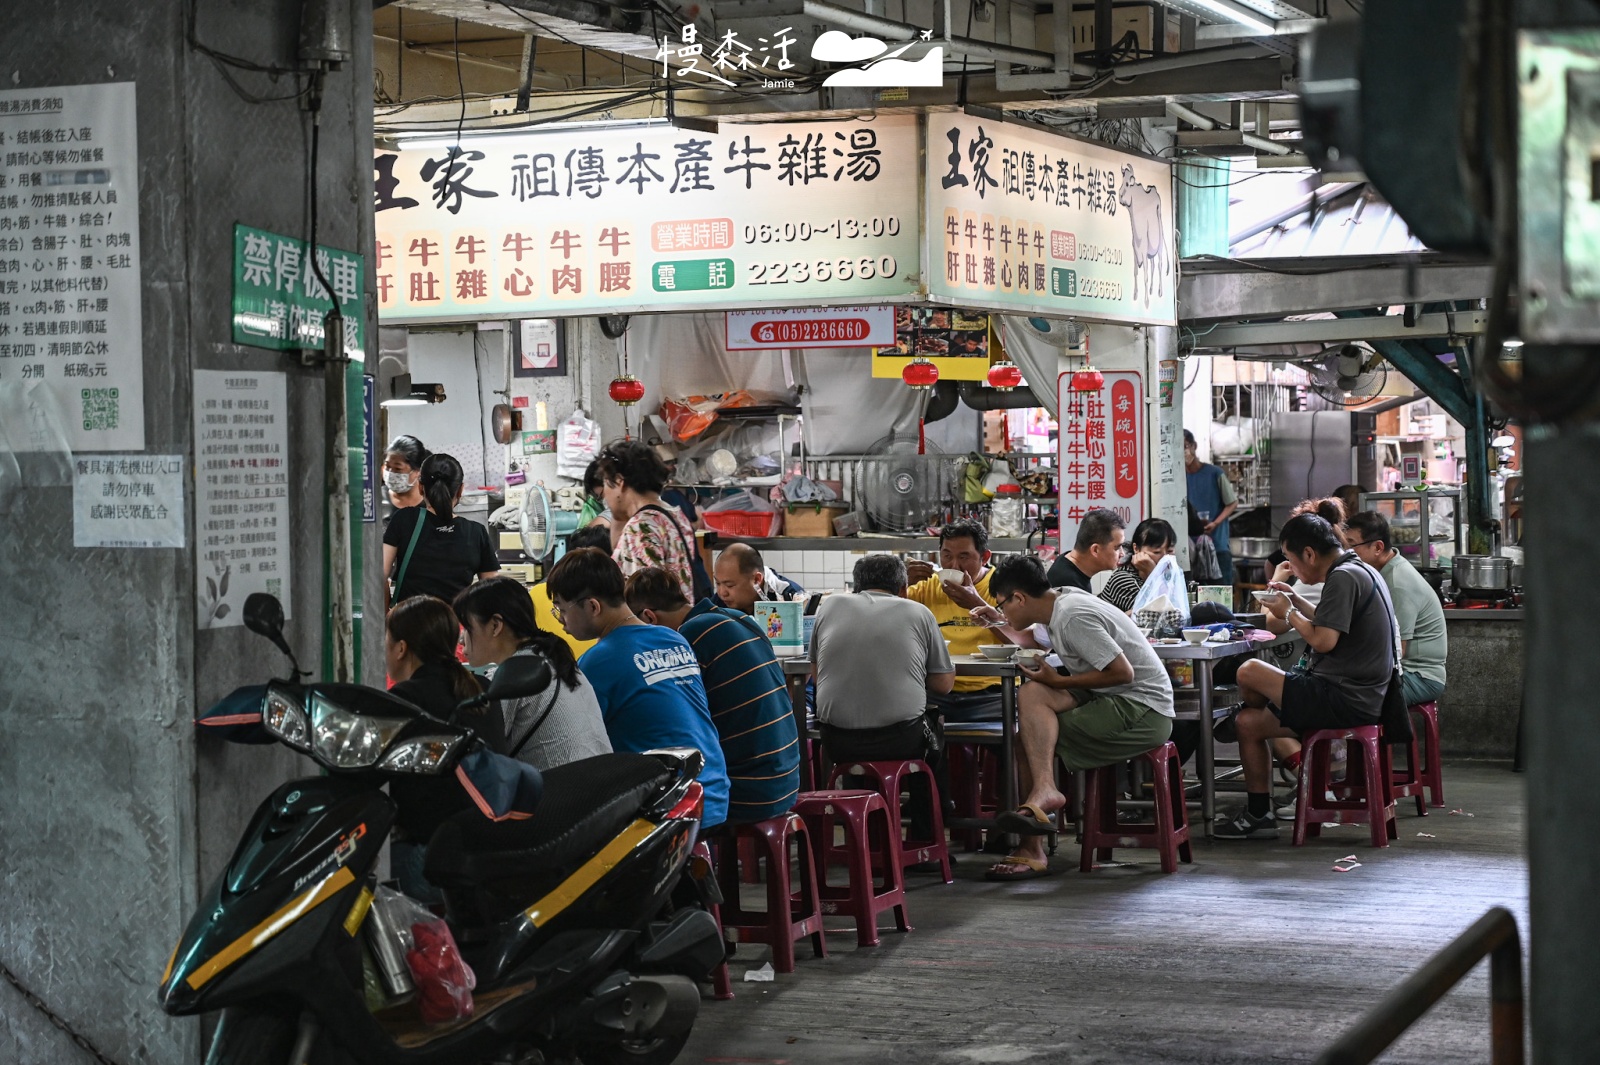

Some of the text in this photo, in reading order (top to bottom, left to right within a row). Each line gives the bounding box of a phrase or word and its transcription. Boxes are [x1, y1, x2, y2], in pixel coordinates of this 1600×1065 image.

[511, 129, 881, 203] 祖傳本產牛雜湯
[942, 125, 1117, 217] 王家 祖傳本產牛雜湯
[455, 235, 488, 299] 牛雜
[502, 232, 534, 297] 牛心
[550, 229, 582, 295] 牛肉
[598, 226, 632, 292] 牛腰
[657, 221, 729, 250] 營業時間
[947, 215, 960, 281] 牛肝
[965, 218, 978, 285] 牛肚
[982, 221, 996, 286] 牛雜
[1000, 224, 1013, 288] 牛心
[1017, 227, 1029, 290] 牛肉
[1033, 229, 1046, 292] 牛腰
[243, 232, 359, 305] 禁停機車
[408, 237, 441, 302] 牛肚
[748, 254, 898, 286] 2236660
[1080, 277, 1123, 301] 2236660
[269, 299, 360, 351] 請依序隊
[777, 321, 863, 341] (05)2236660
[22, 364, 45, 379] 分開
[77, 460, 180, 475] 餐具清洗機出入口
[103, 482, 155, 497] 請勿停車
[1067, 461, 1106, 480] 牛肉
[1067, 481, 1106, 500] 牛腰
[90, 504, 168, 519] 感謝民眾配合
